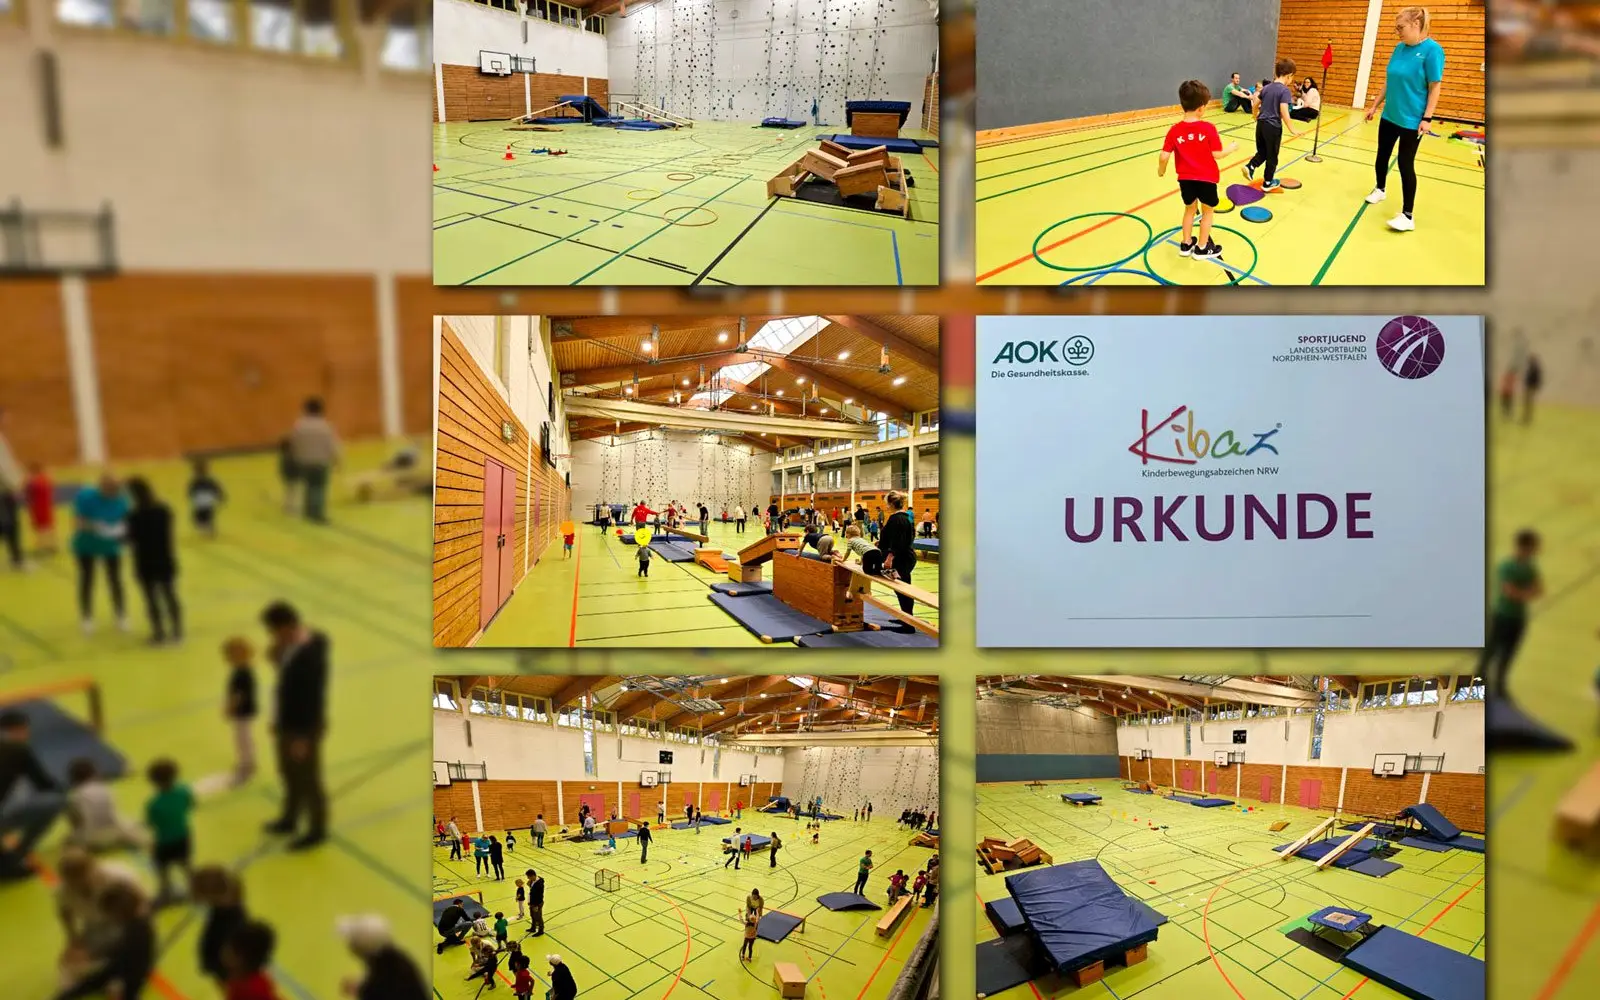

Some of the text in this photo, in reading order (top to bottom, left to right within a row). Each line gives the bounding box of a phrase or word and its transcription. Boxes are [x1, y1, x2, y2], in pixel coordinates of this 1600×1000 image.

[1298, 334, 1366, 344] SPORTJUGEND
[992, 340, 1059, 364] AOK
[1289, 346, 1367, 354] LANDESSPORTBUND
[1272, 353, 1367, 362] NORDRHEIN-WESTFALEN
[991, 369, 1090, 378] Die Gesundheitskasse.
[1141, 467, 1280, 479] Kinderbewegungsabzeichen NRW
[1065, 492, 1374, 544] URKUNDE
